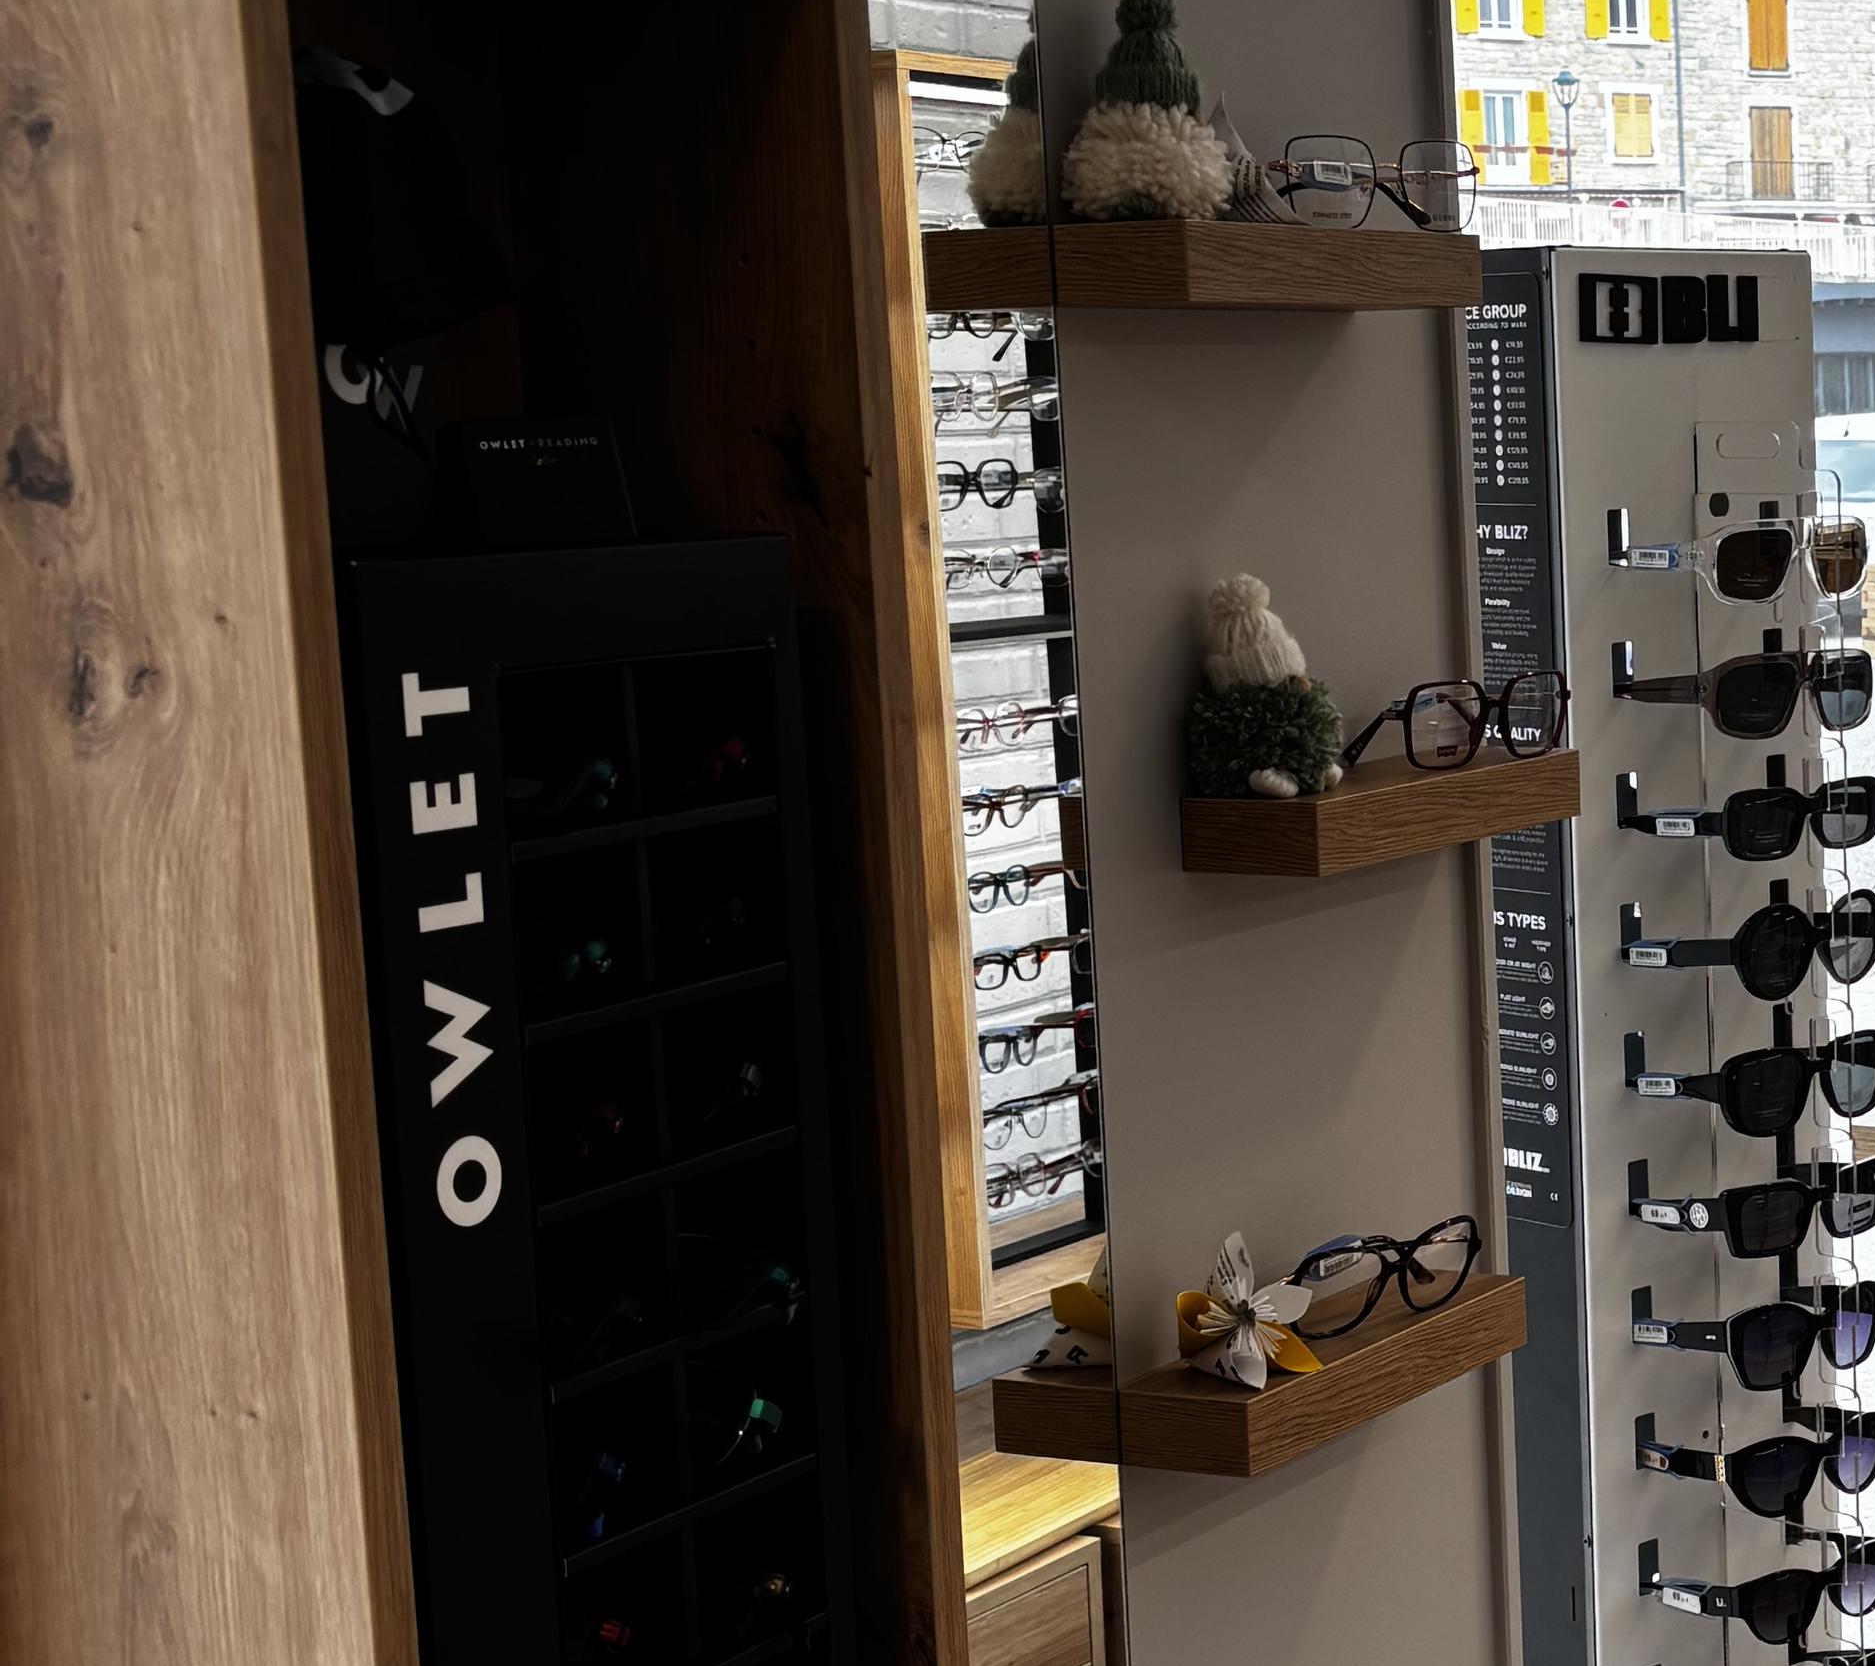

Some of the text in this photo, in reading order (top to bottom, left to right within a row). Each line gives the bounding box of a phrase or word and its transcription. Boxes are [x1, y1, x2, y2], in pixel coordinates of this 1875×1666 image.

[1482, 303, 1527, 319] GROUP
[1494, 524, 1529, 540] BLIZ?
[1507, 912, 1547, 930] TYPES
[401, 671, 503, 1228] OWLET
